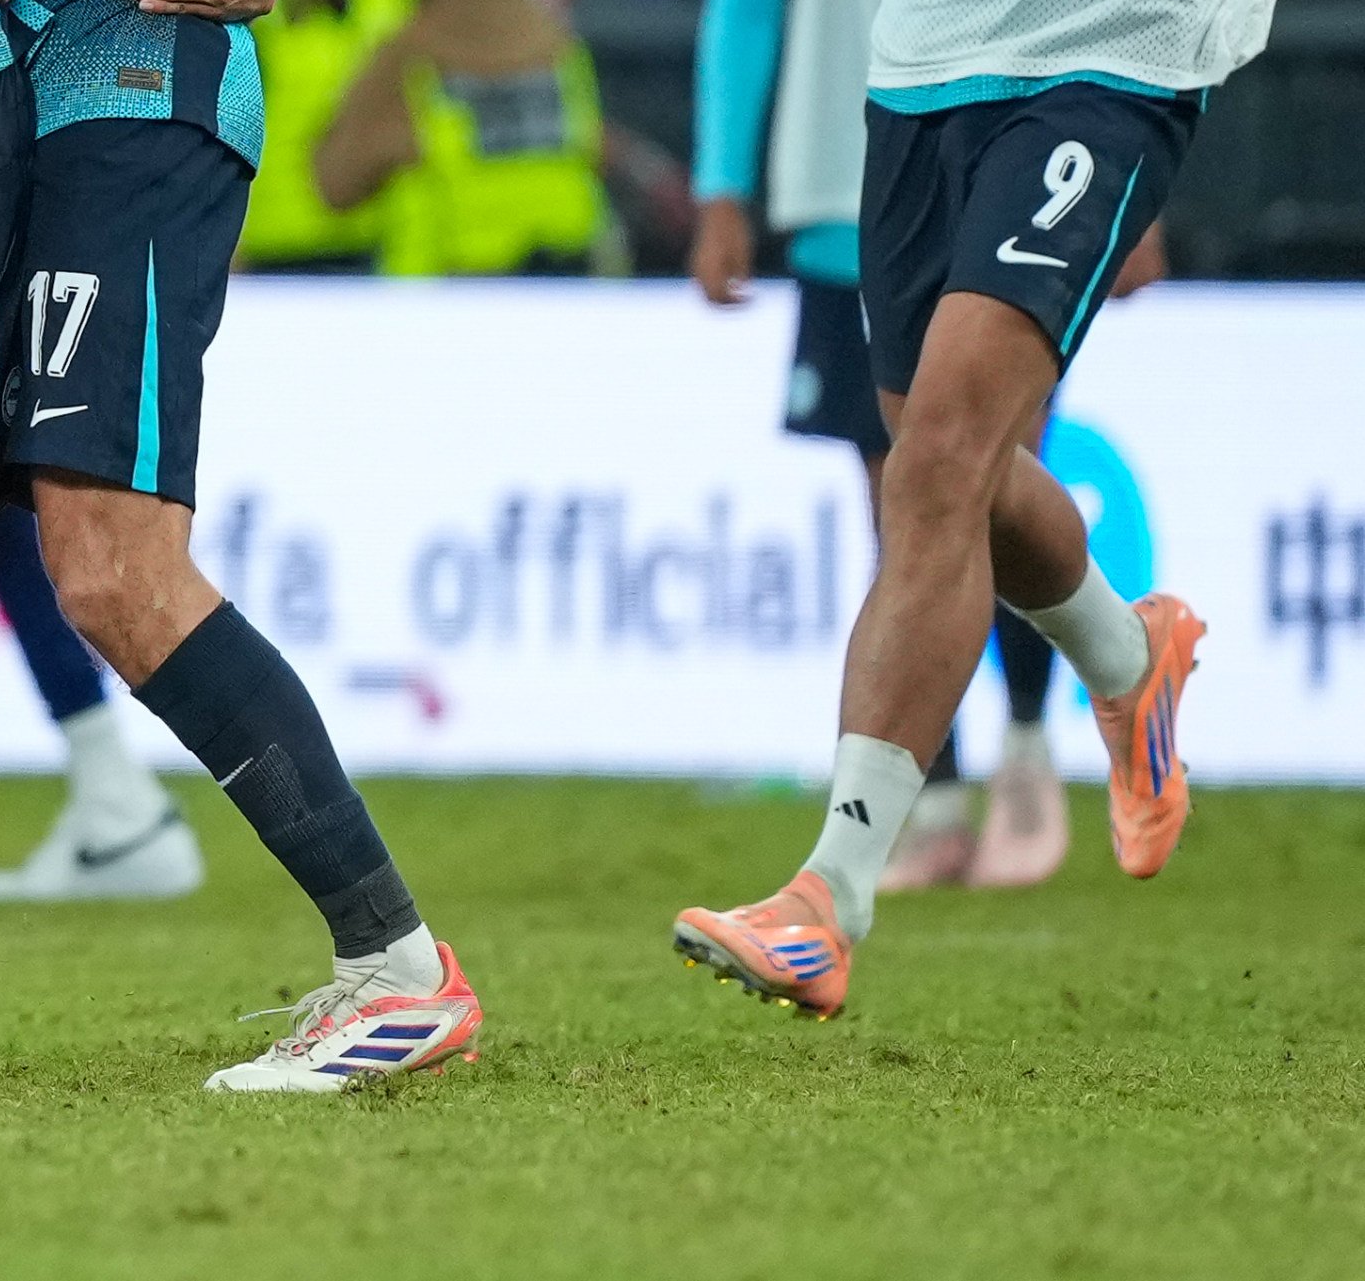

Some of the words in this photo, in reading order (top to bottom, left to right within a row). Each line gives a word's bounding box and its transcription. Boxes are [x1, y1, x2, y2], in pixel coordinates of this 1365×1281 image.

[1031, 140, 1095, 231] 9
[27, 270, 101, 378] 17
[212, 488, 848, 695] fa_official
